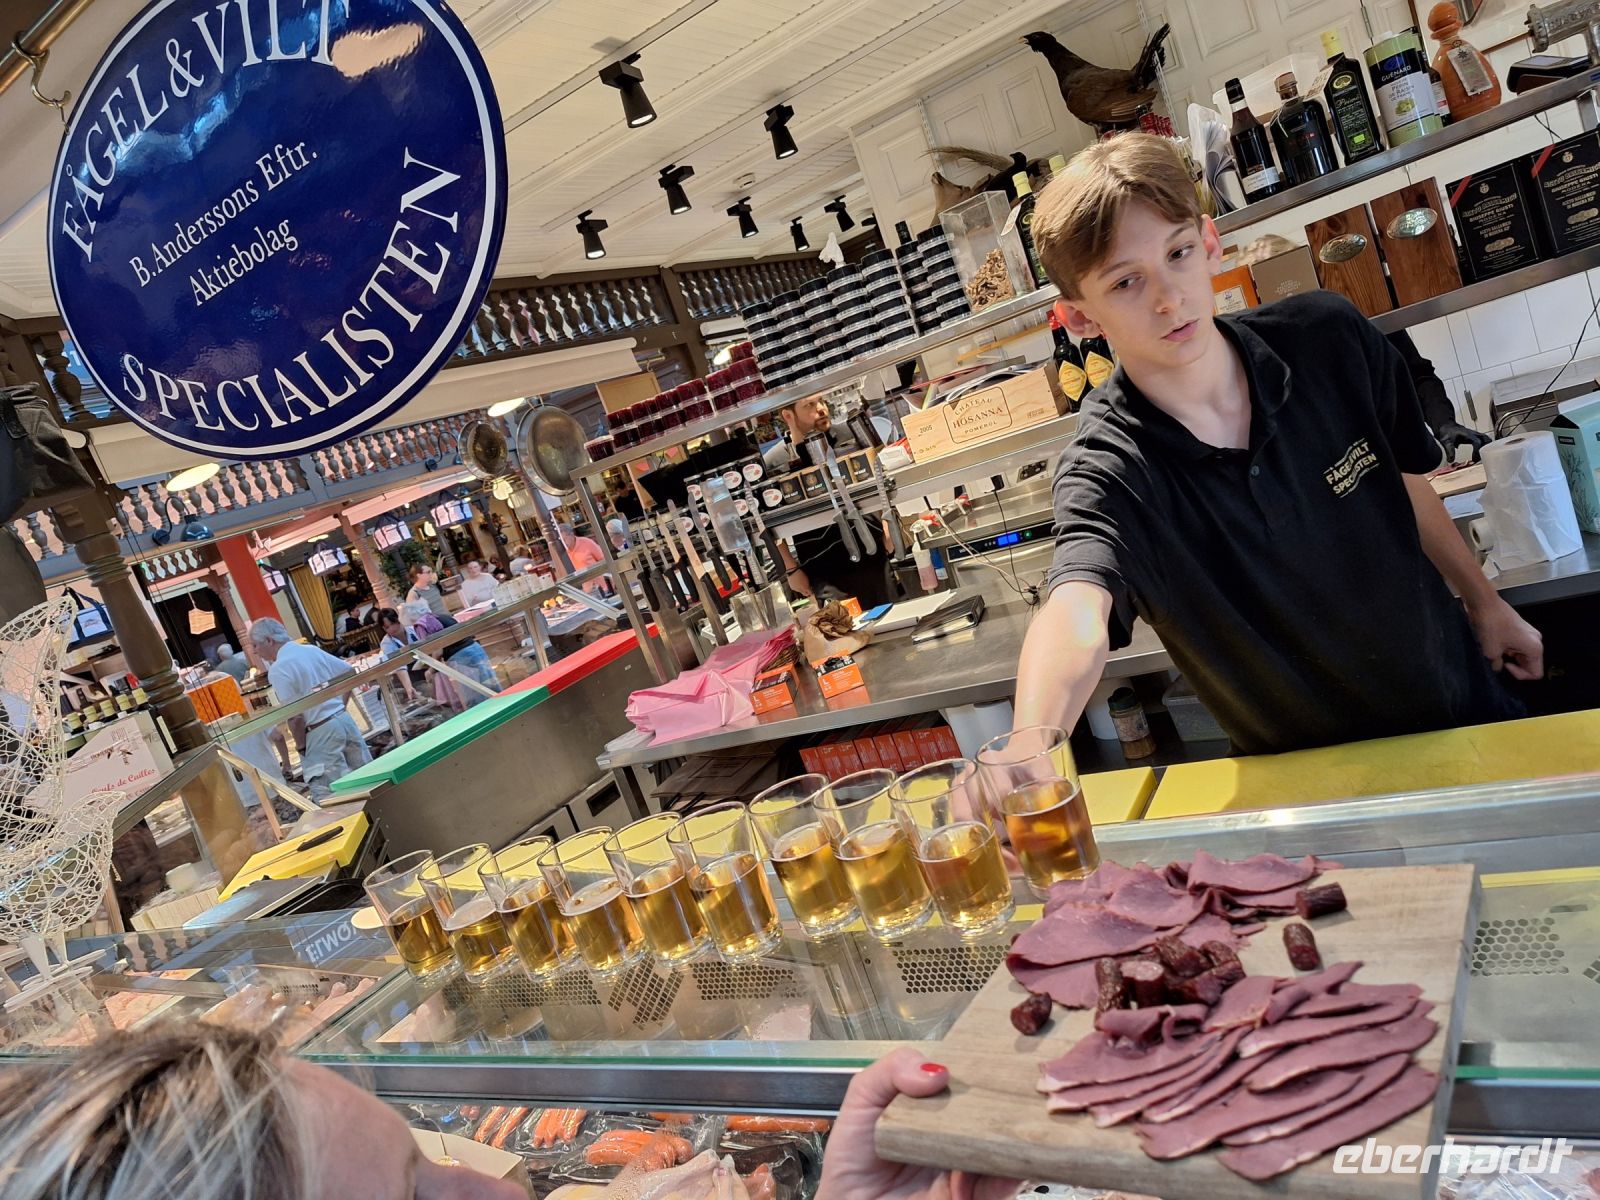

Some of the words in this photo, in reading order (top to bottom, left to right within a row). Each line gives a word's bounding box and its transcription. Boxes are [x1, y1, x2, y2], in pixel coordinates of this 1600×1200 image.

[255, 139, 318, 193] Eftr.
[189, 218, 298, 307] Aktiebolag
[123, 147, 462, 432] SPECIALISTEN
[919, 424, 933, 434] 2005
[952, 407, 1004, 430] HOSANNA
[964, 420, 997, 434] POMEROL
